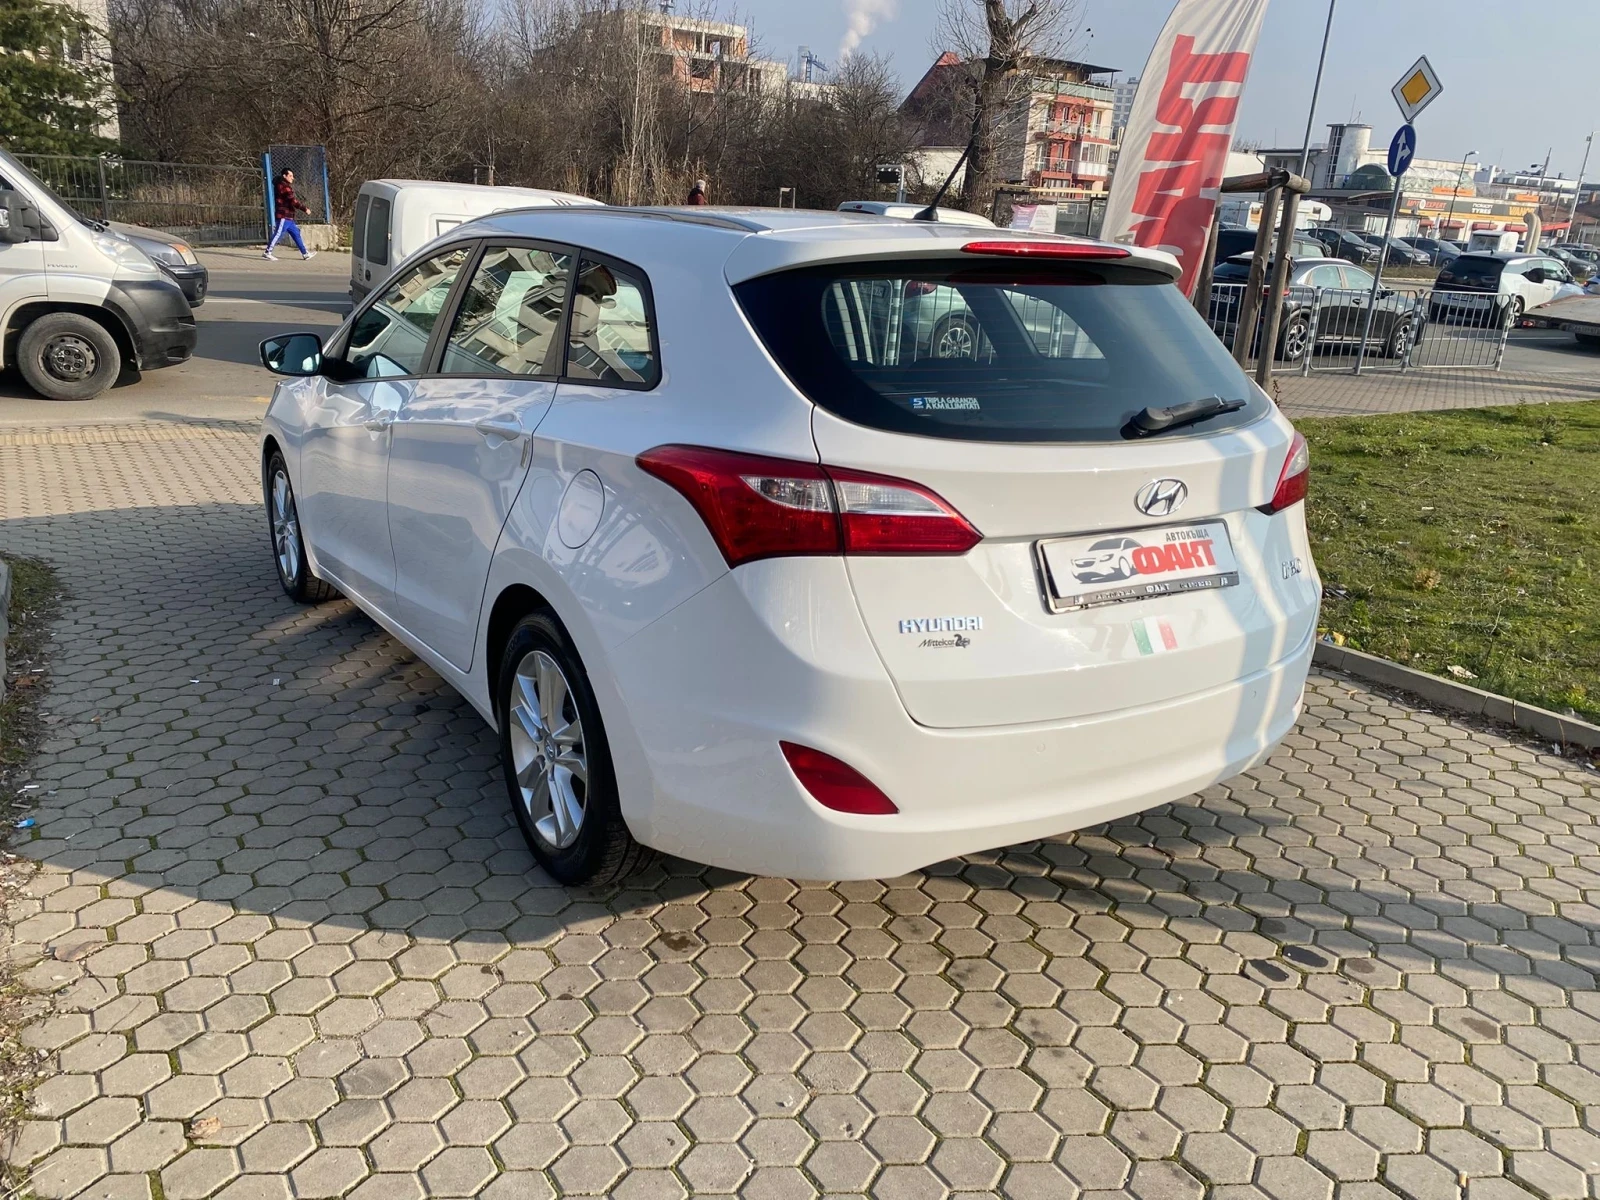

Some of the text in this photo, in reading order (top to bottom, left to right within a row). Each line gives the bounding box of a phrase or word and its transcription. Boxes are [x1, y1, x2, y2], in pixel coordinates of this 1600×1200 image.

[913, 397, 923, 406] 5
[1165, 528, 1210, 542] АВТОКЪЩА
[1131, 539, 1216, 575] ФАКТ
[1281, 557, 1303, 580] i30
[1145, 583, 1171, 593] ФАКТ
[898, 616, 983, 634] HYUNDAI
